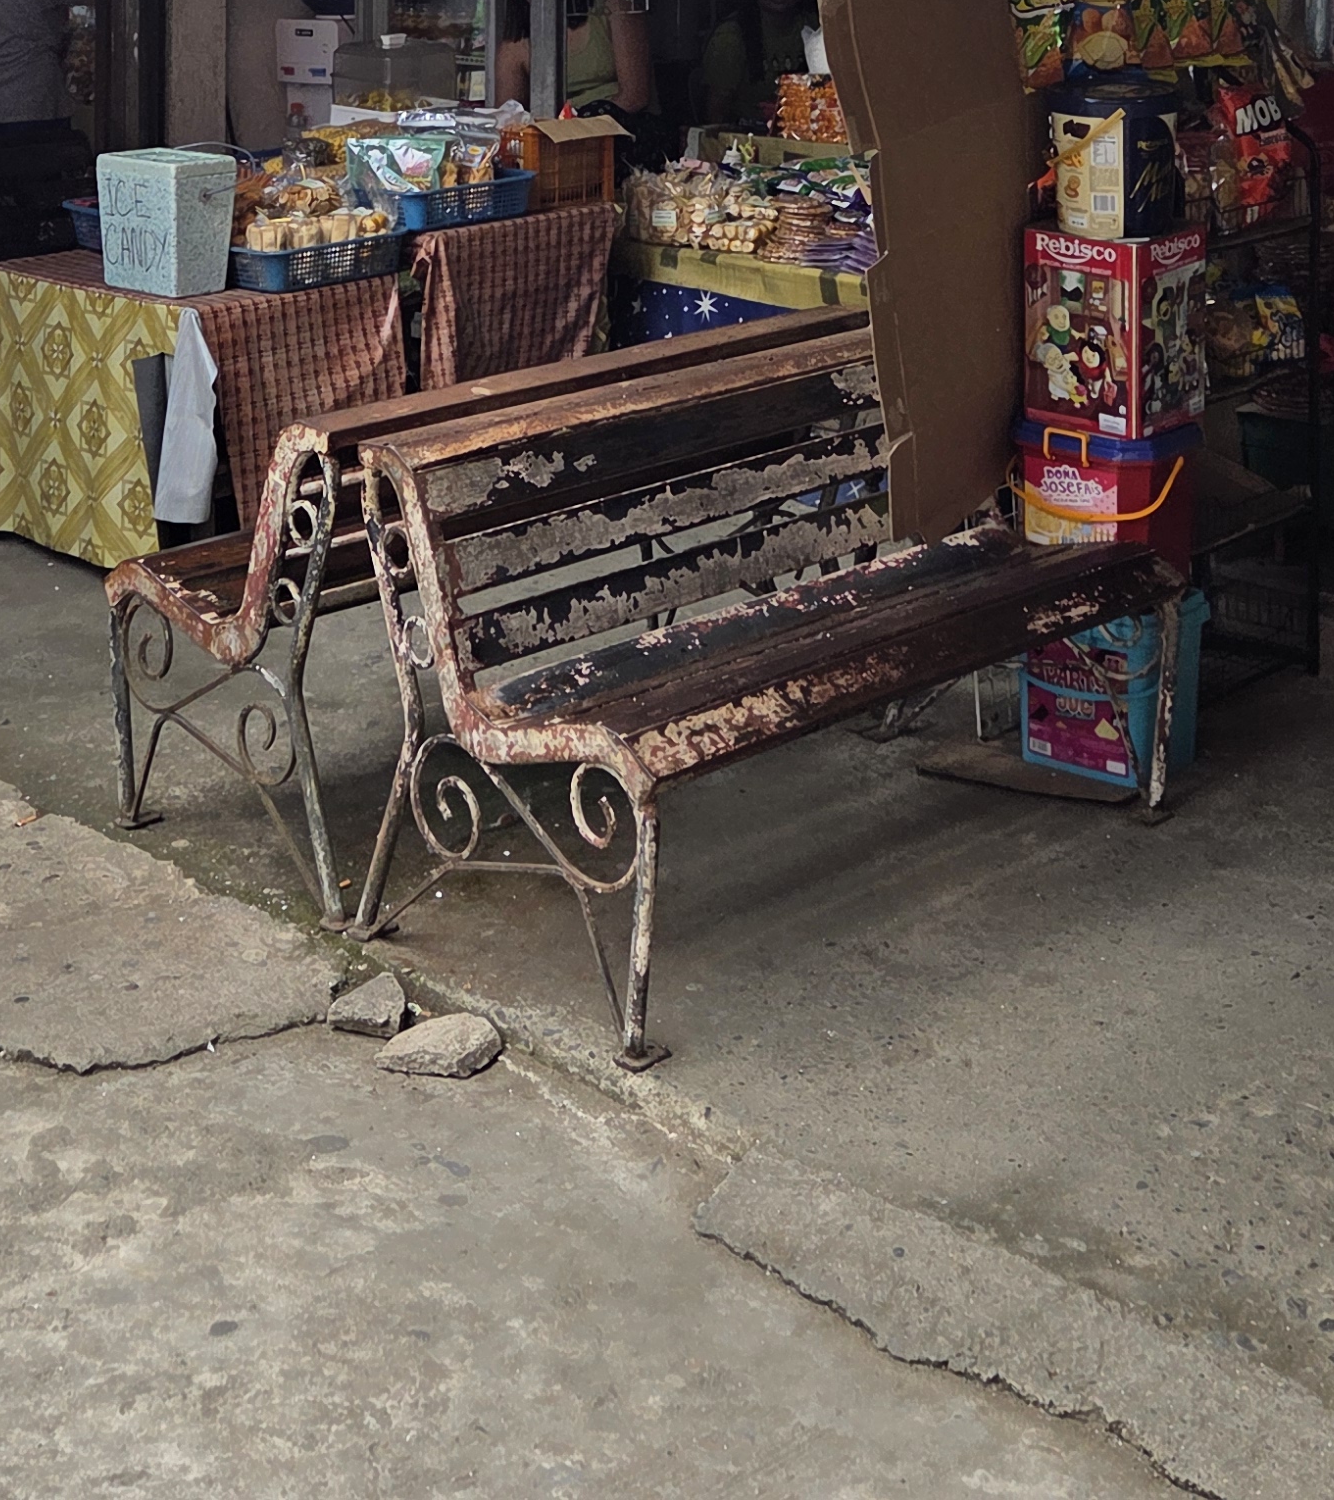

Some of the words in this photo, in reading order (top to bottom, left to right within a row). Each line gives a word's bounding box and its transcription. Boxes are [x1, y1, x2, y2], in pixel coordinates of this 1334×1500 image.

[1235, 95, 1282, 135] MOB
[105, 177, 151, 219] ICE
[105, 223, 168, 272] CANDY
[1036, 233, 1117, 263] Rebisco
[1151, 234, 1201, 264] Rebisco
